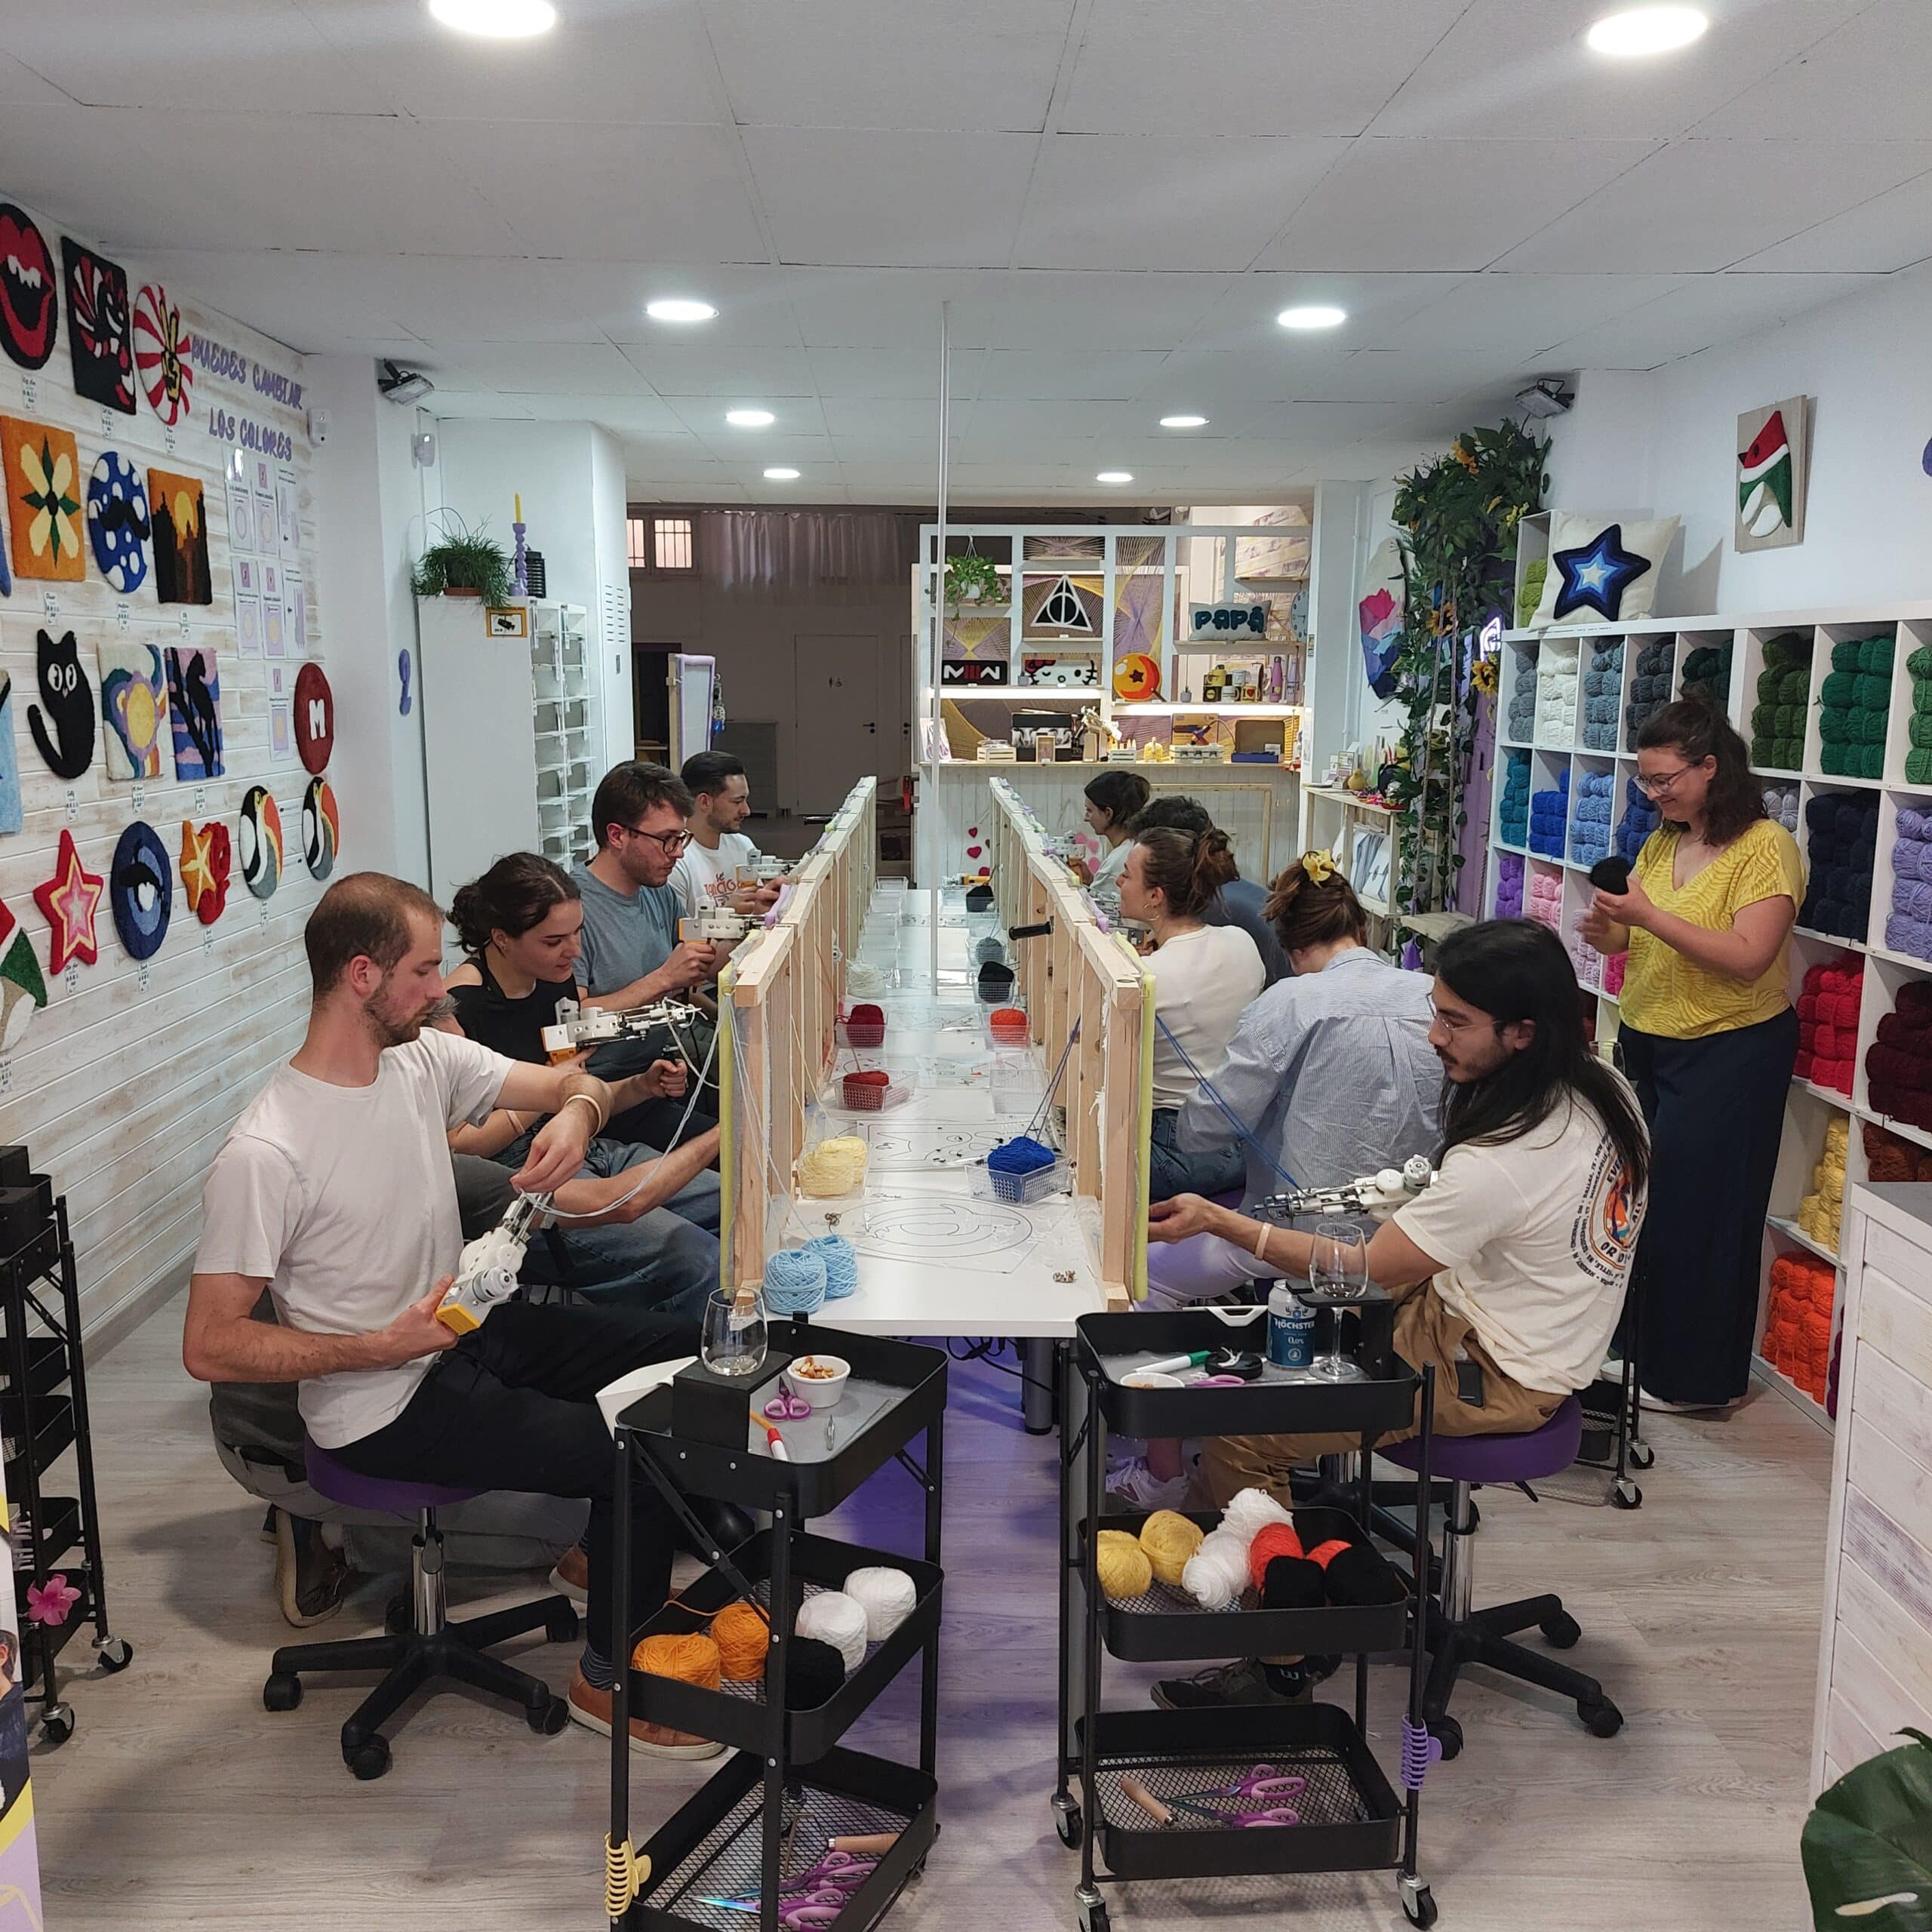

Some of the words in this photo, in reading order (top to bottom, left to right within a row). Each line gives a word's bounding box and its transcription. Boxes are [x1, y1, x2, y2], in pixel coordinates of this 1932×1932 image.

[253, 363, 303, 410] CAMBIAR
[209, 407, 235, 441] LOS
[240, 419, 292, 461] COLORES
[1601, 1242, 1617, 1257] OR
